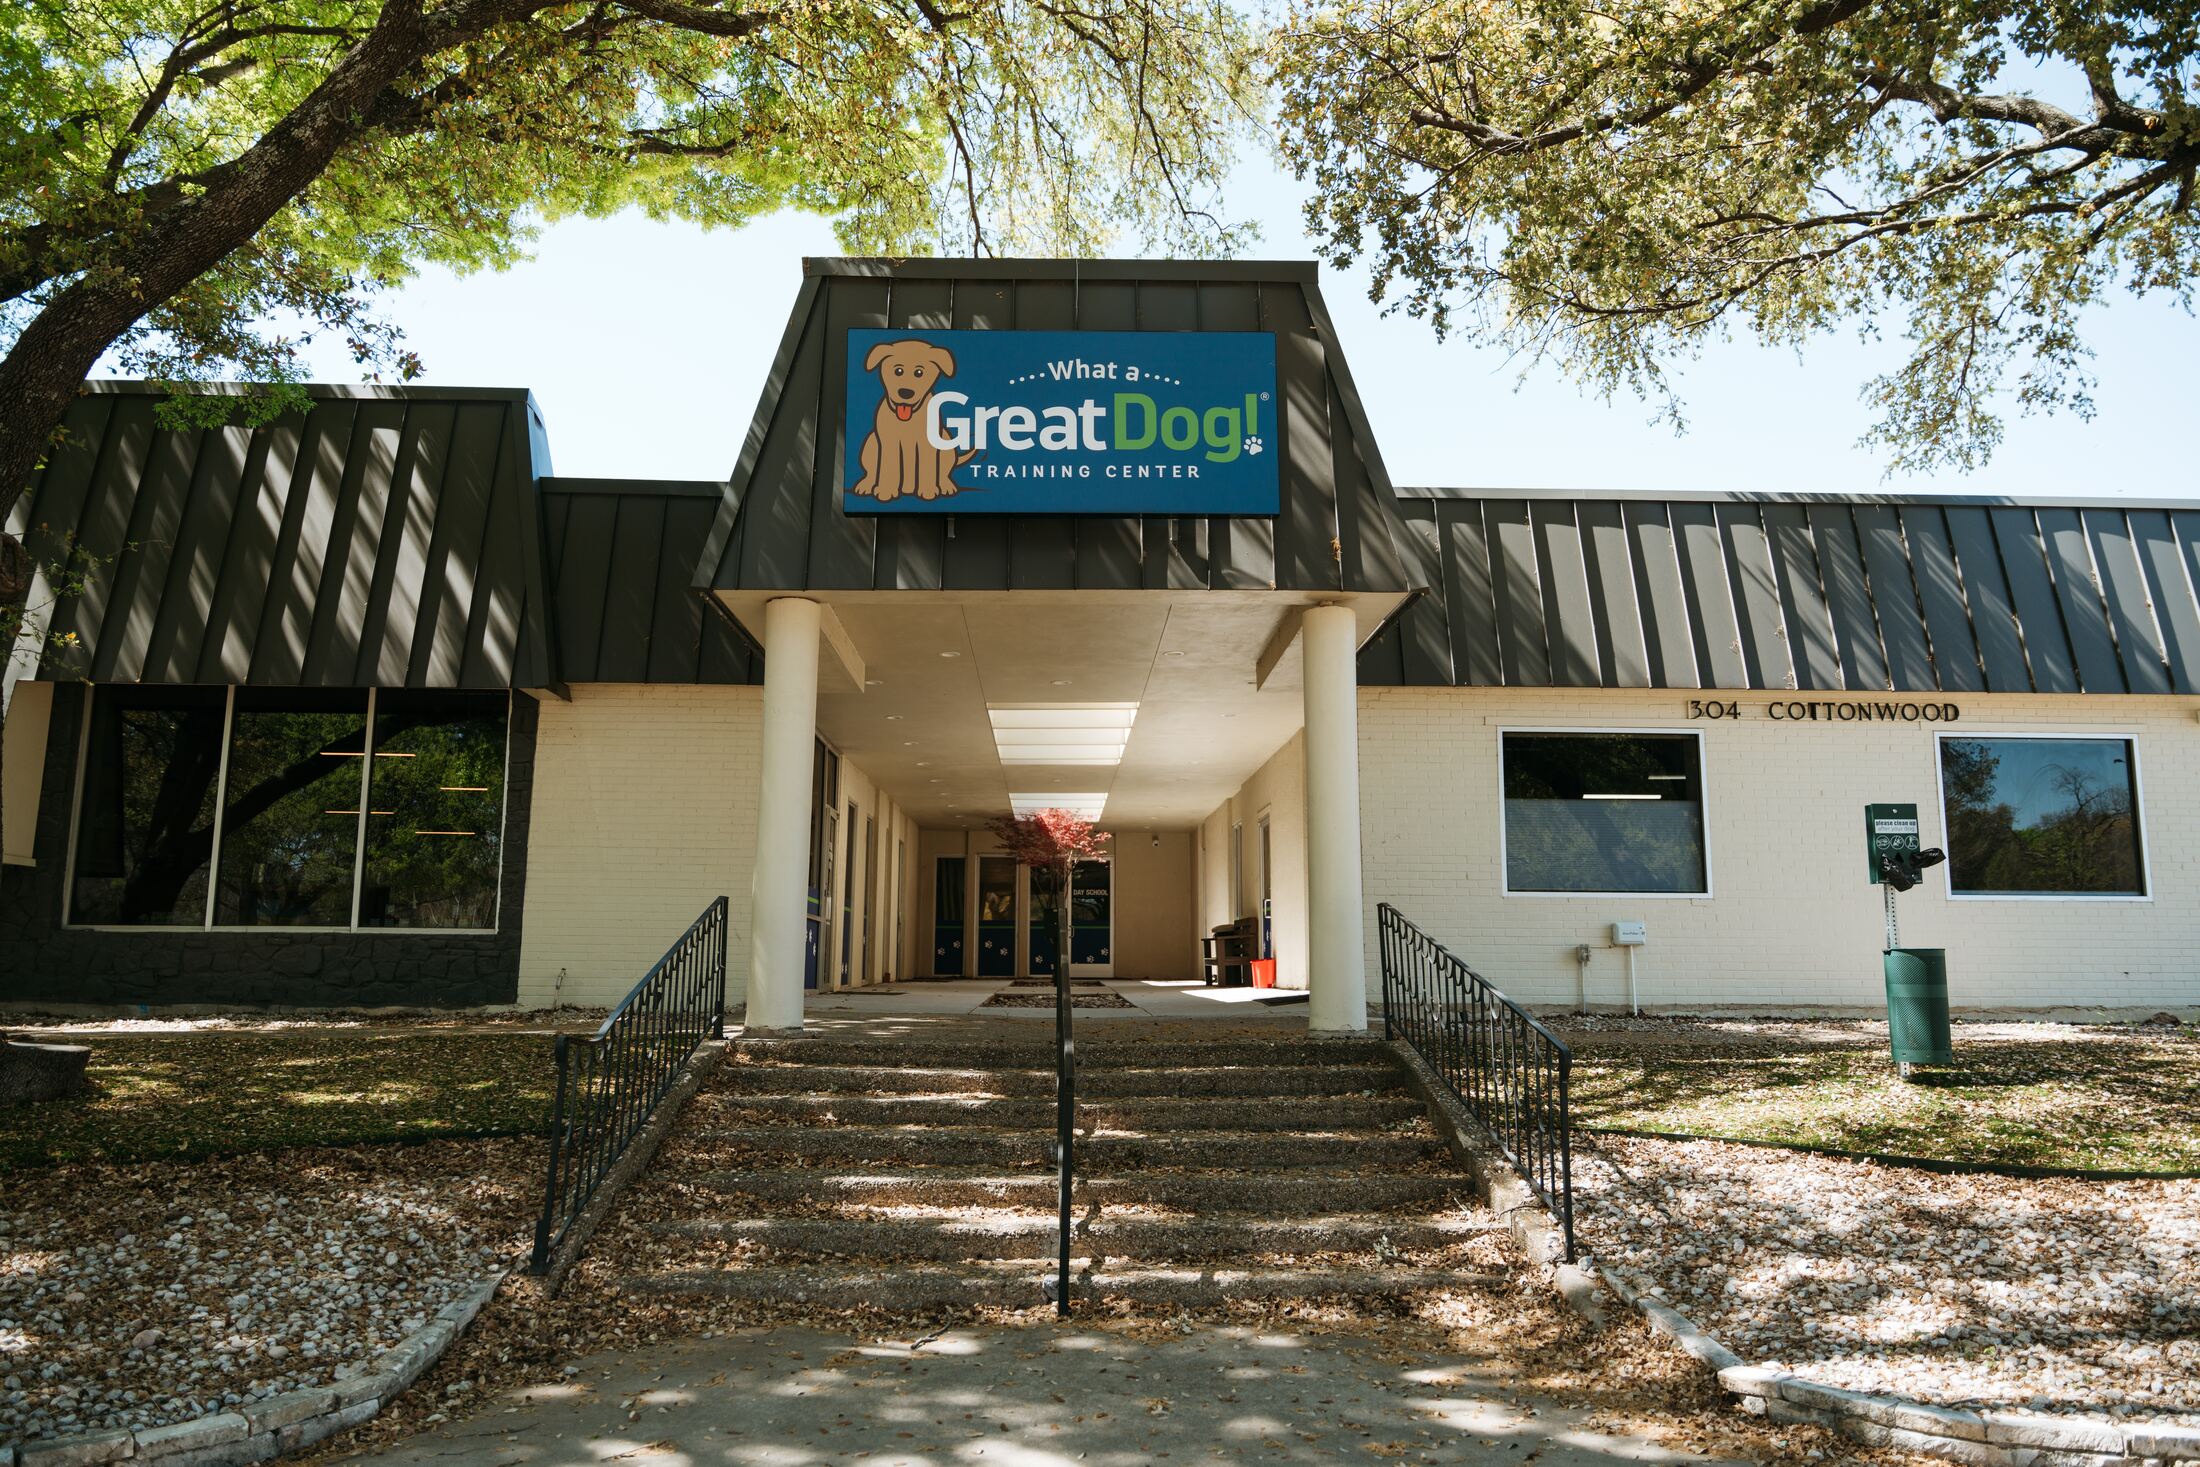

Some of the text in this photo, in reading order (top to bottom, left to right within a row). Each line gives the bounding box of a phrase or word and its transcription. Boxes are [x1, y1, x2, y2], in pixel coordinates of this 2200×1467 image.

[1047, 358, 1140, 382] What a
[970, 465, 1200, 478] TRAINING CENTER
[1690, 701, 1960, 722] 304 COTTONWOOD
